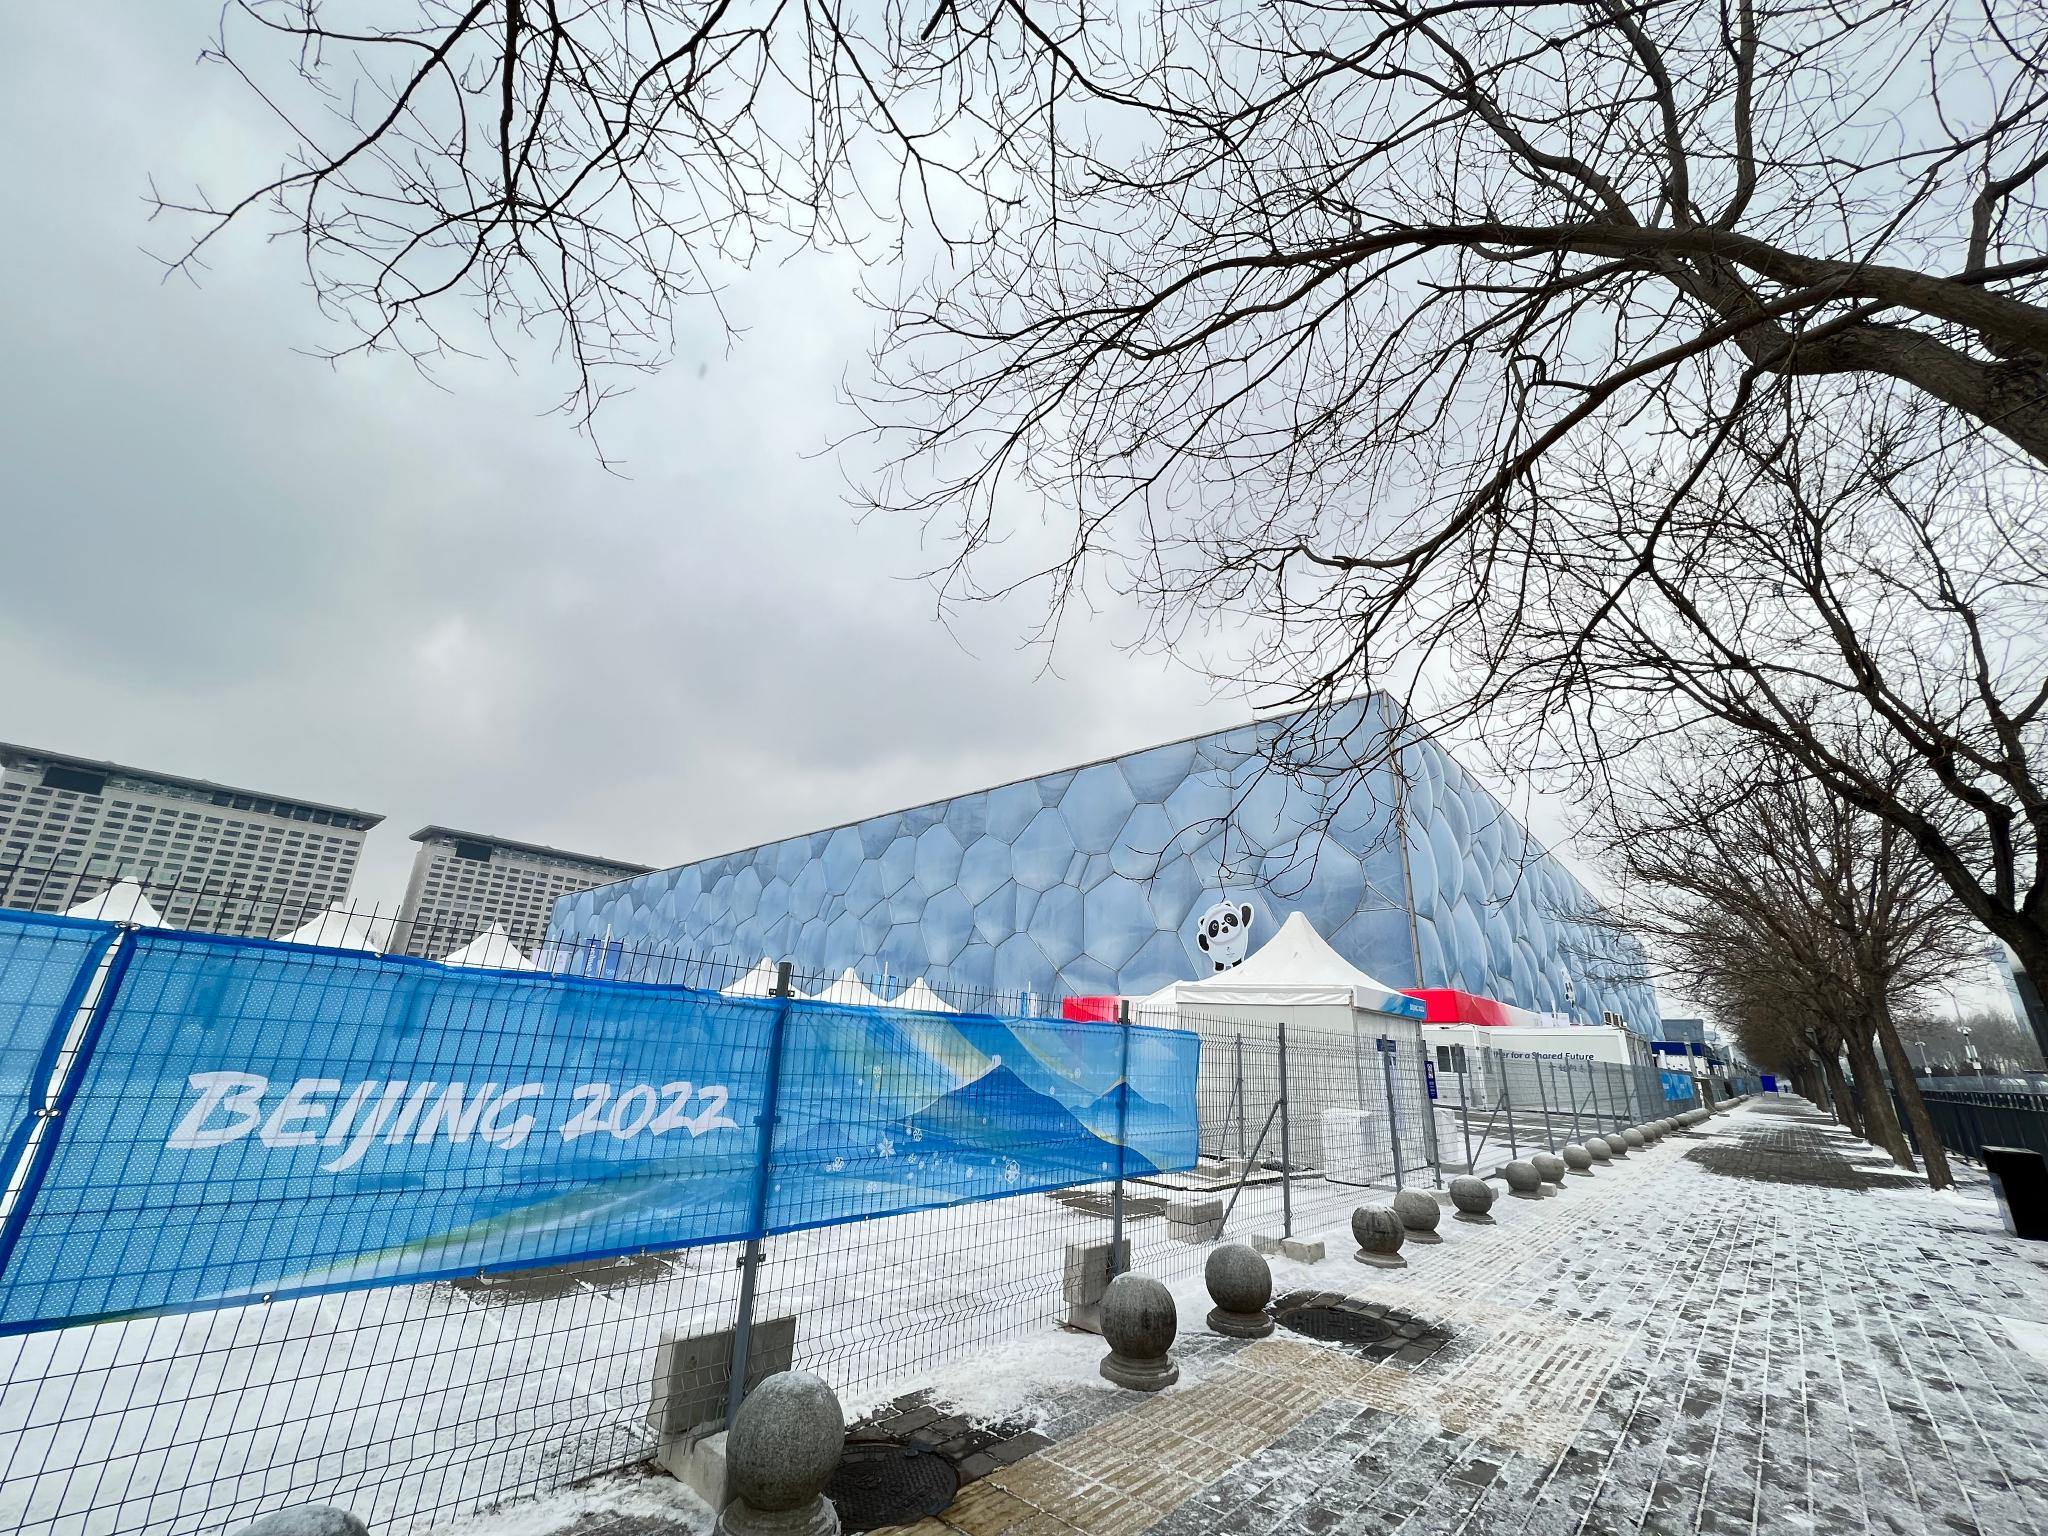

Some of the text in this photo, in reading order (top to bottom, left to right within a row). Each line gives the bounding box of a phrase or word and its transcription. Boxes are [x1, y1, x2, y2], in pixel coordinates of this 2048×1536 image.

[1511, 1051, 1523, 1059] for
[1531, 1051, 1563, 1060] Shared
[1565, 1052, 1594, 1061] Future
[165, 1070, 741, 1173] BEIJING 2022
